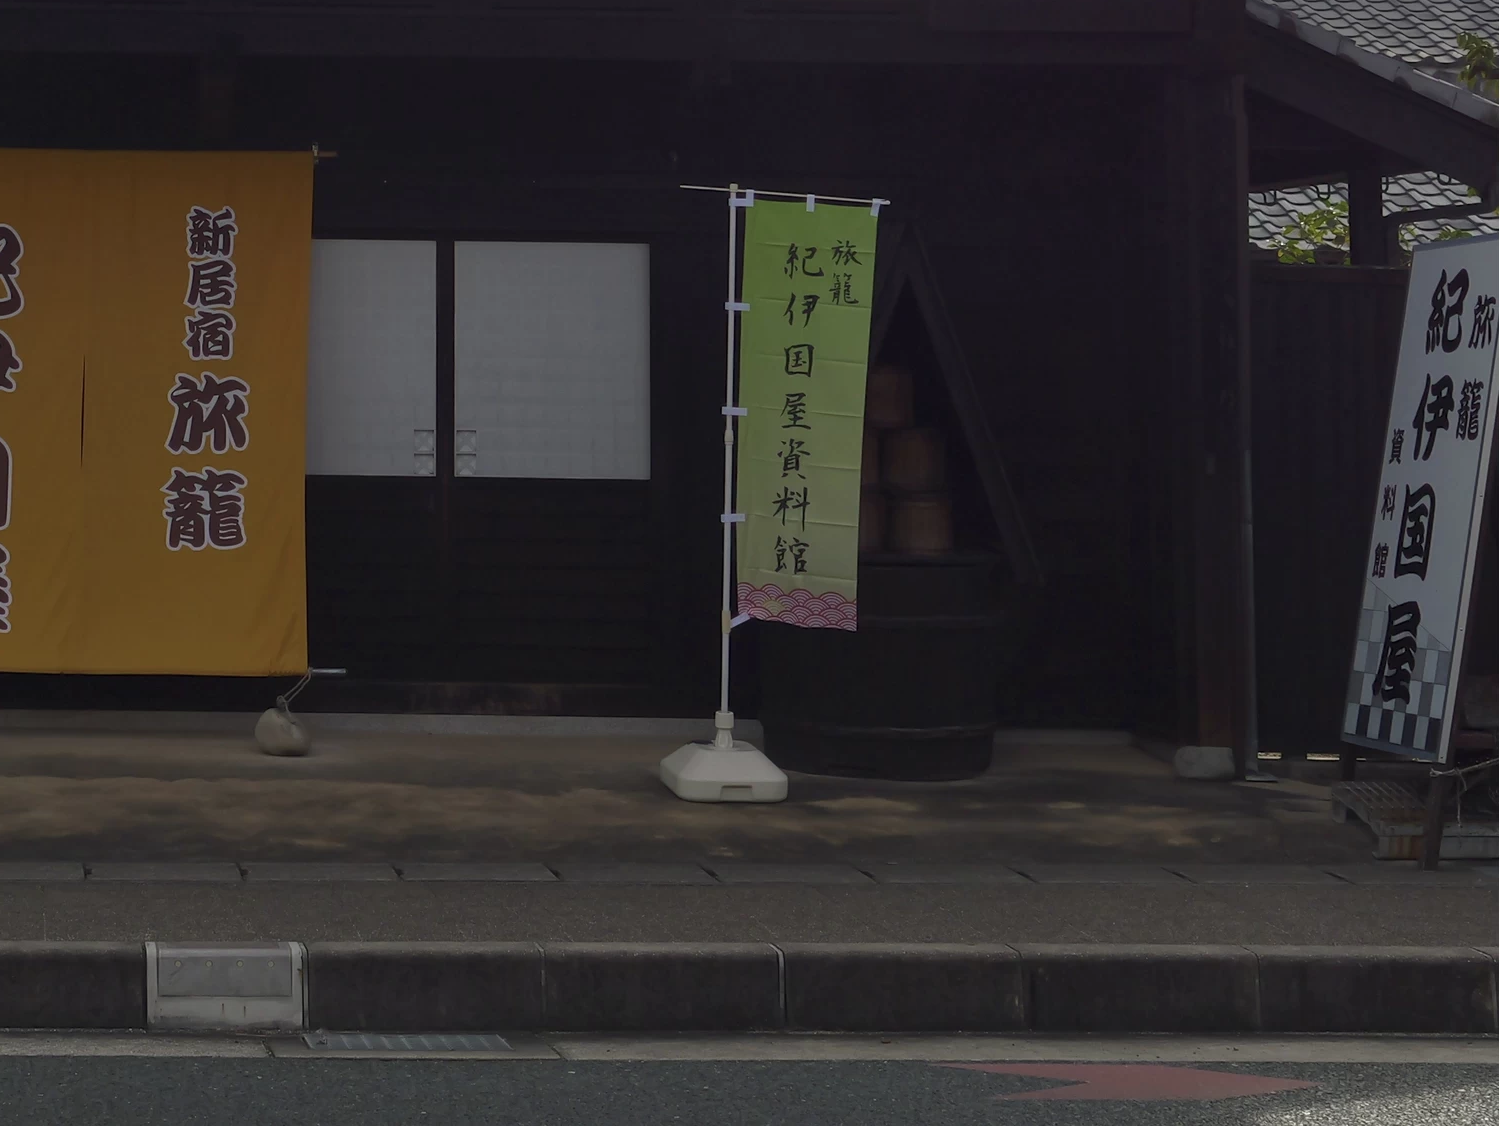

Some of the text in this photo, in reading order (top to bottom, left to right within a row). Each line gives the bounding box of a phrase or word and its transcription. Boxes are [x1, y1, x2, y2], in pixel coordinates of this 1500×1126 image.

[161, 205, 250, 551] 新居宿 旅籠
[829, 239, 863, 306] 旅籠
[1455, 295, 1498, 441] 旅籠
[772, 243, 824, 575] 紀伊国屋資料館
[1372, 268, 1470, 705] 紀伊国屋
[1372, 429, 1404, 579] 資料館
